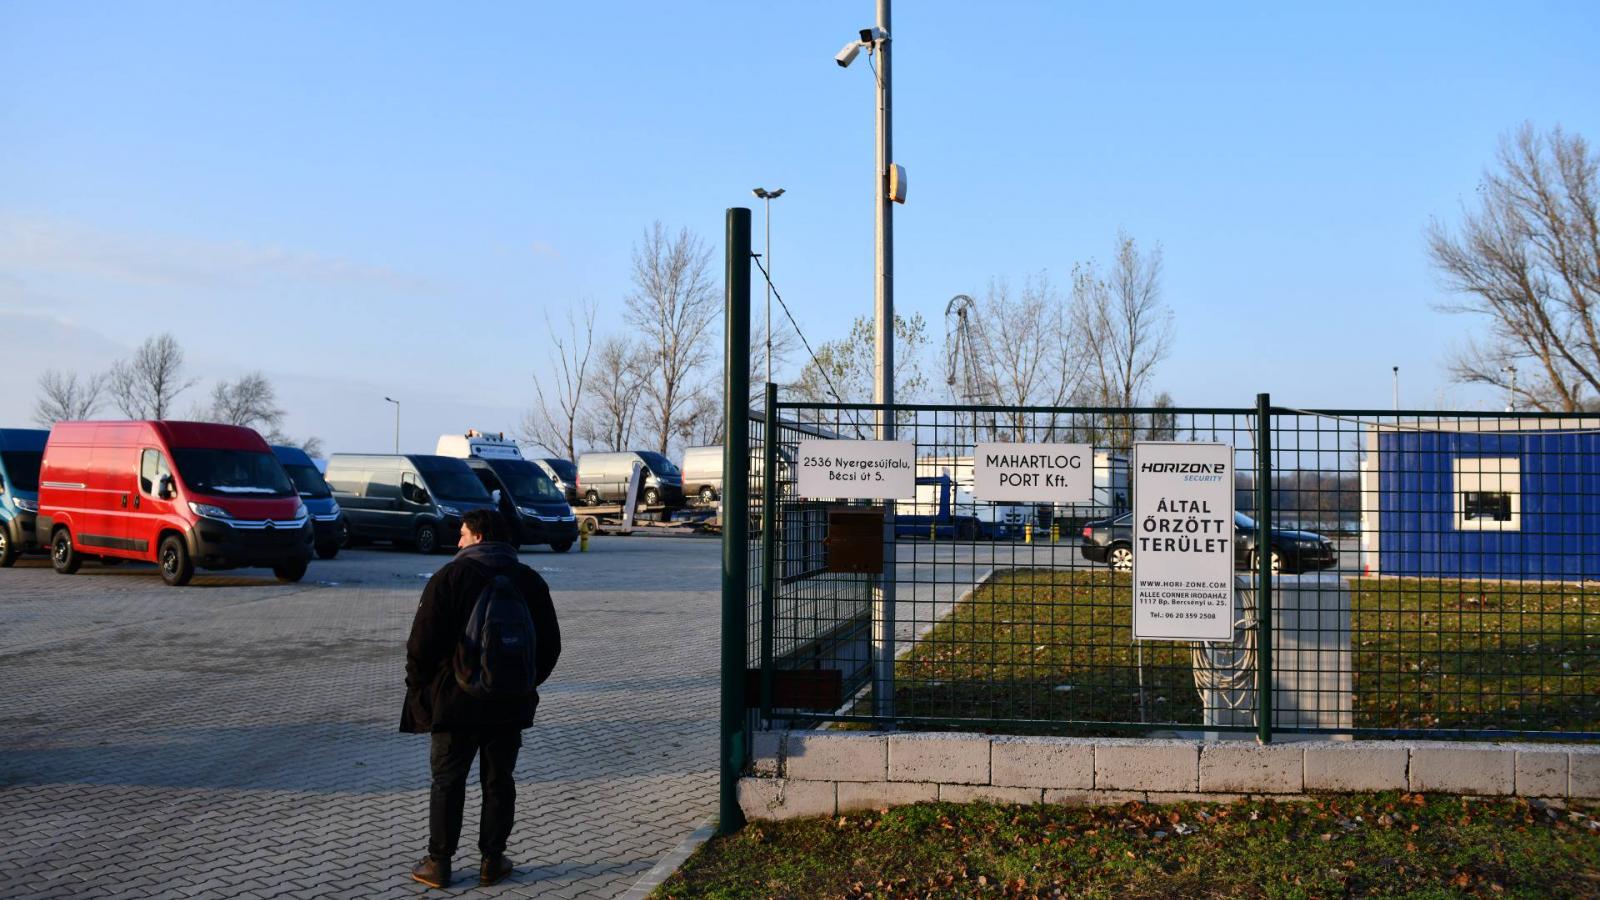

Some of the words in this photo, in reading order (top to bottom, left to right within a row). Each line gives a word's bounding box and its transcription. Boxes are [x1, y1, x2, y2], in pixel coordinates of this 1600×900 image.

[803, 456, 832, 468] 2536
[835, 457, 910, 470] Nyergesújfalu,
[986, 454, 1081, 469] MAHARTLOG
[828, 470, 857, 481] Bécsi
[860, 470, 872, 481] út
[875, 471, 885, 482] 5.
[999, 473, 1040, 487] PORT
[1045, 473, 1068, 488] Kft.
[1157, 497, 1211, 513] ÁLTAL
[1143, 515, 1224, 533] ŐRZÖTT
[1139, 535, 1228, 553] TERÜLET
